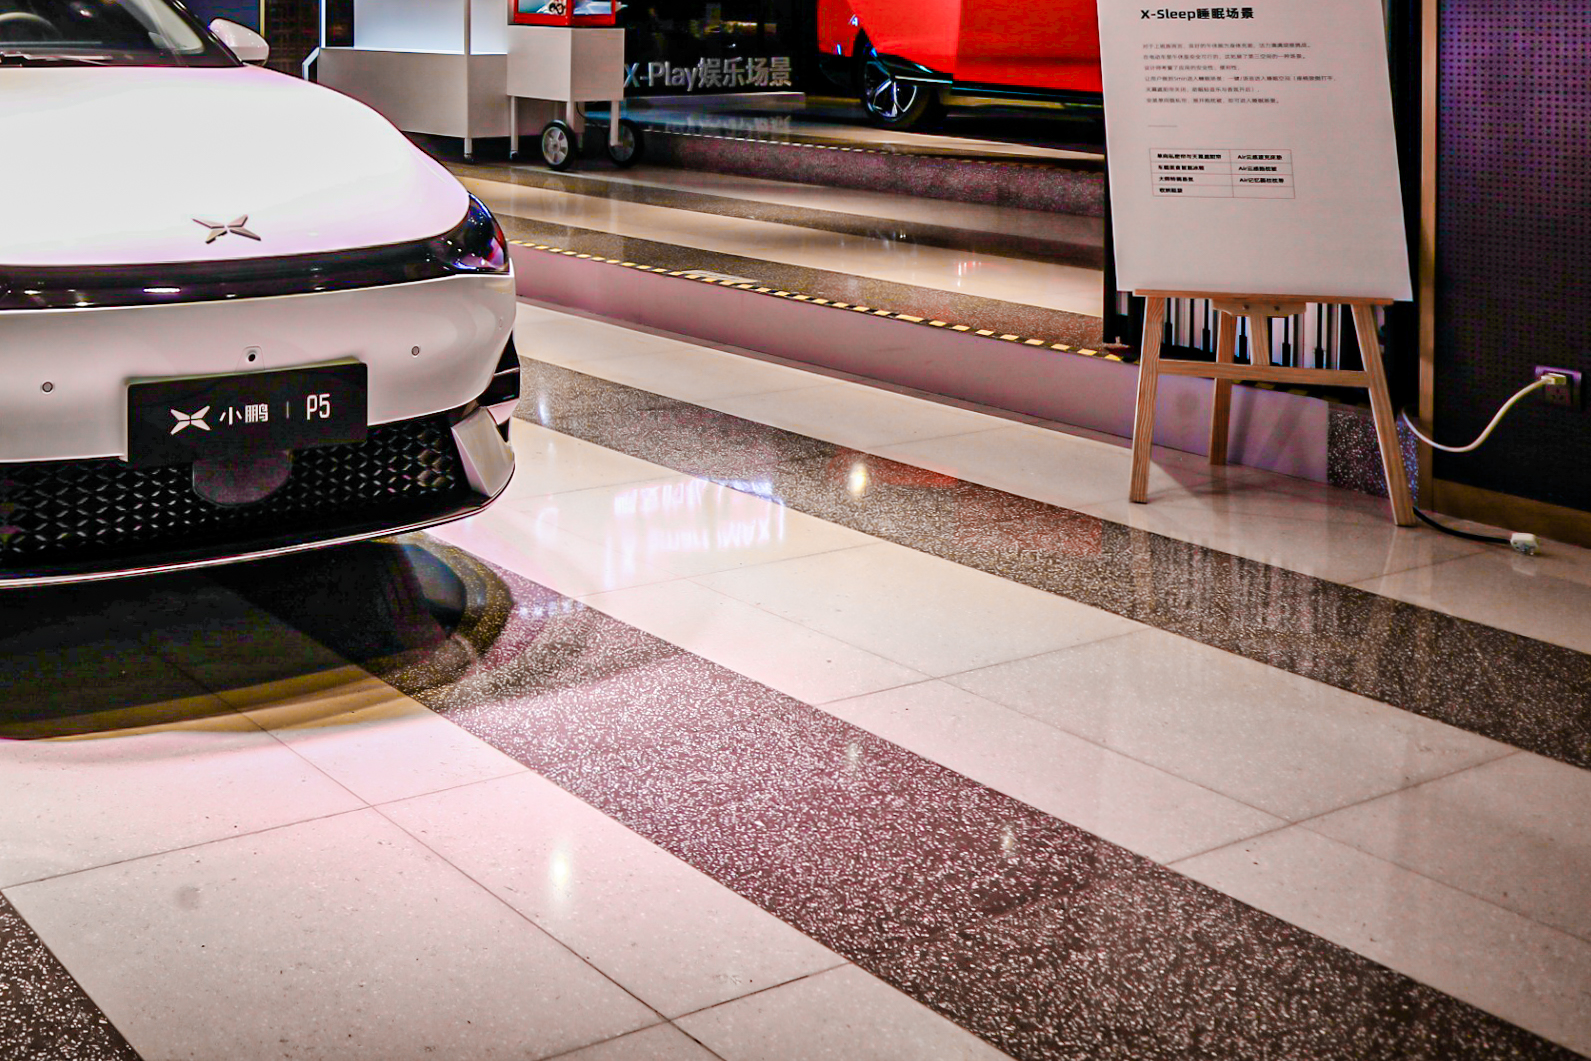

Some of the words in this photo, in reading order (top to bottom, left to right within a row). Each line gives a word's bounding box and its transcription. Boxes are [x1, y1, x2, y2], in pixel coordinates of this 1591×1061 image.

[1140, 7, 1255, 21] X-Sleep睡眠场景
[219, 403, 269, 426] 小鹏
[306, 393, 331, 421] P5
